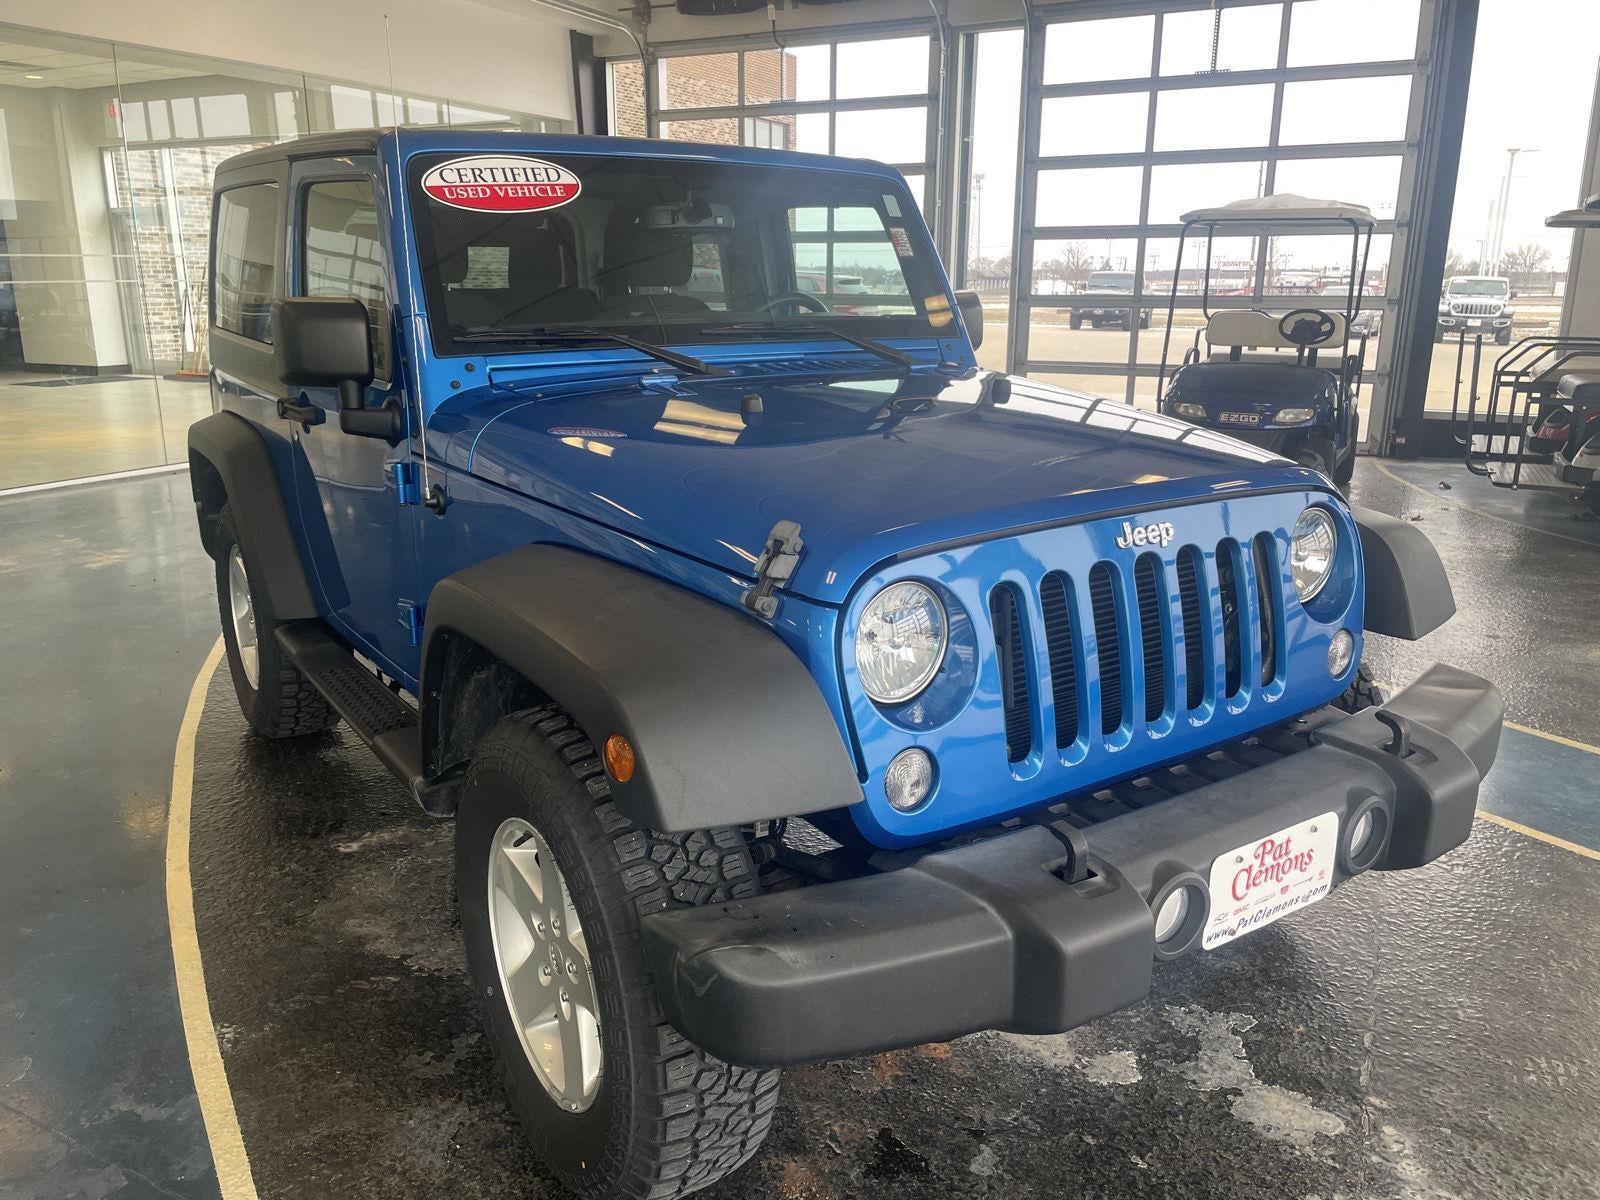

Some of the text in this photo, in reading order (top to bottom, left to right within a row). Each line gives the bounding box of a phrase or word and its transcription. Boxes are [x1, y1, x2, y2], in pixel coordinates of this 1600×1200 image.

[439, 167, 561, 184] CERTIFIED
[443, 185, 566, 199] USED VEHICLE
[1114, 521, 1175, 549] Jeep
[1253, 836, 1292, 868] Pat
[1231, 848, 1314, 902] Clemons
[1206, 884, 1328, 943] wwwPatClemonscom
